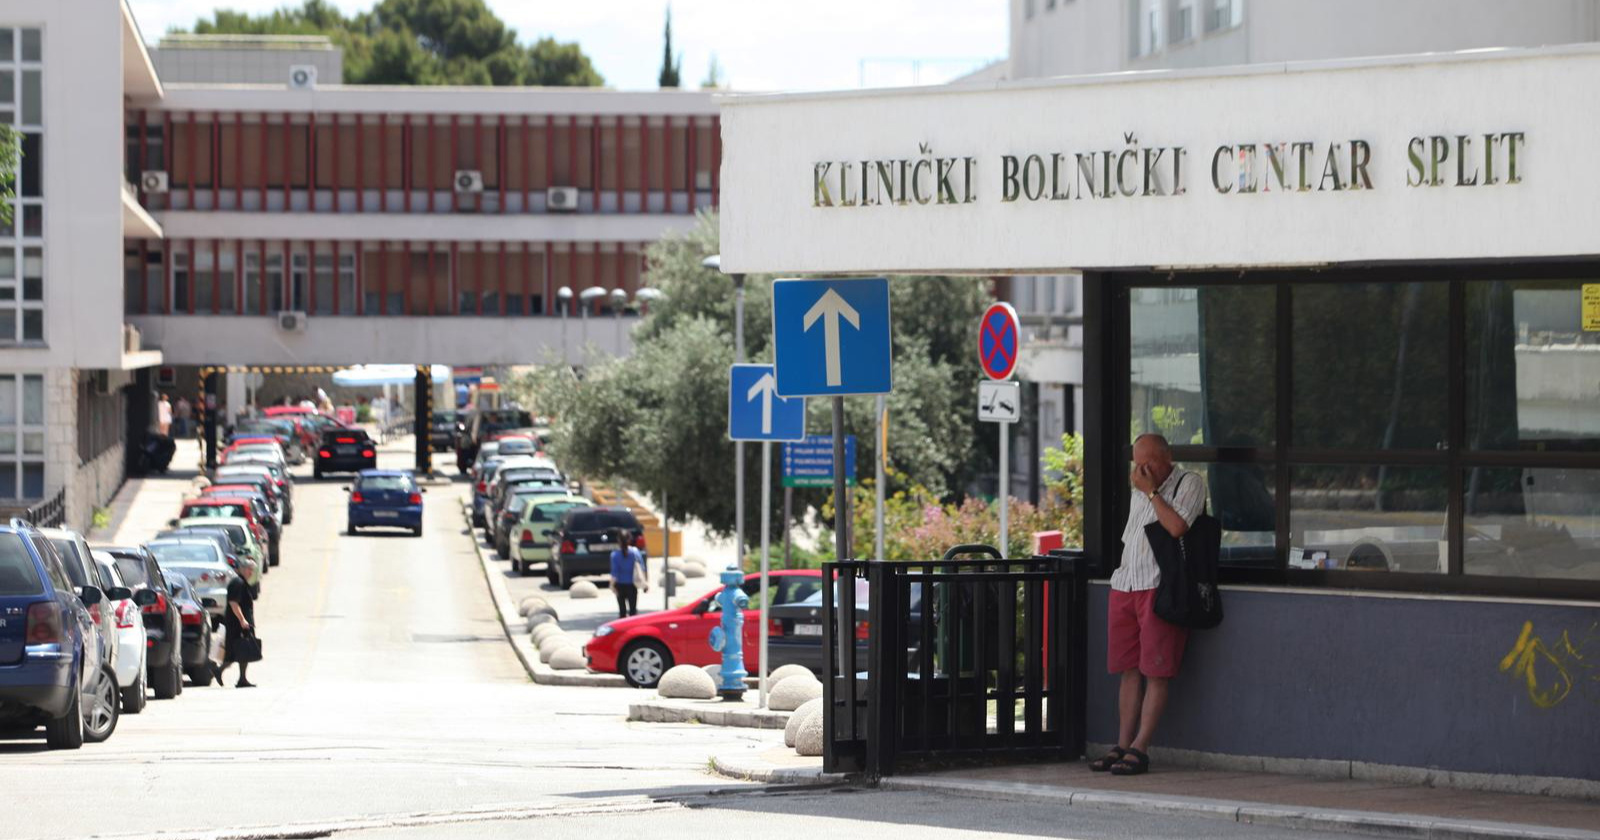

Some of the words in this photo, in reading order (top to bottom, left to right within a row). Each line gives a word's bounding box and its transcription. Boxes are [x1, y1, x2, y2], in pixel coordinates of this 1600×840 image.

[811, 141, 976, 207] KLINIČKI
[1000, 131, 1187, 202] BOLNIČKI
[1211, 139, 1374, 194] CENTAR
[1407, 131, 1525, 187] SPLIT
